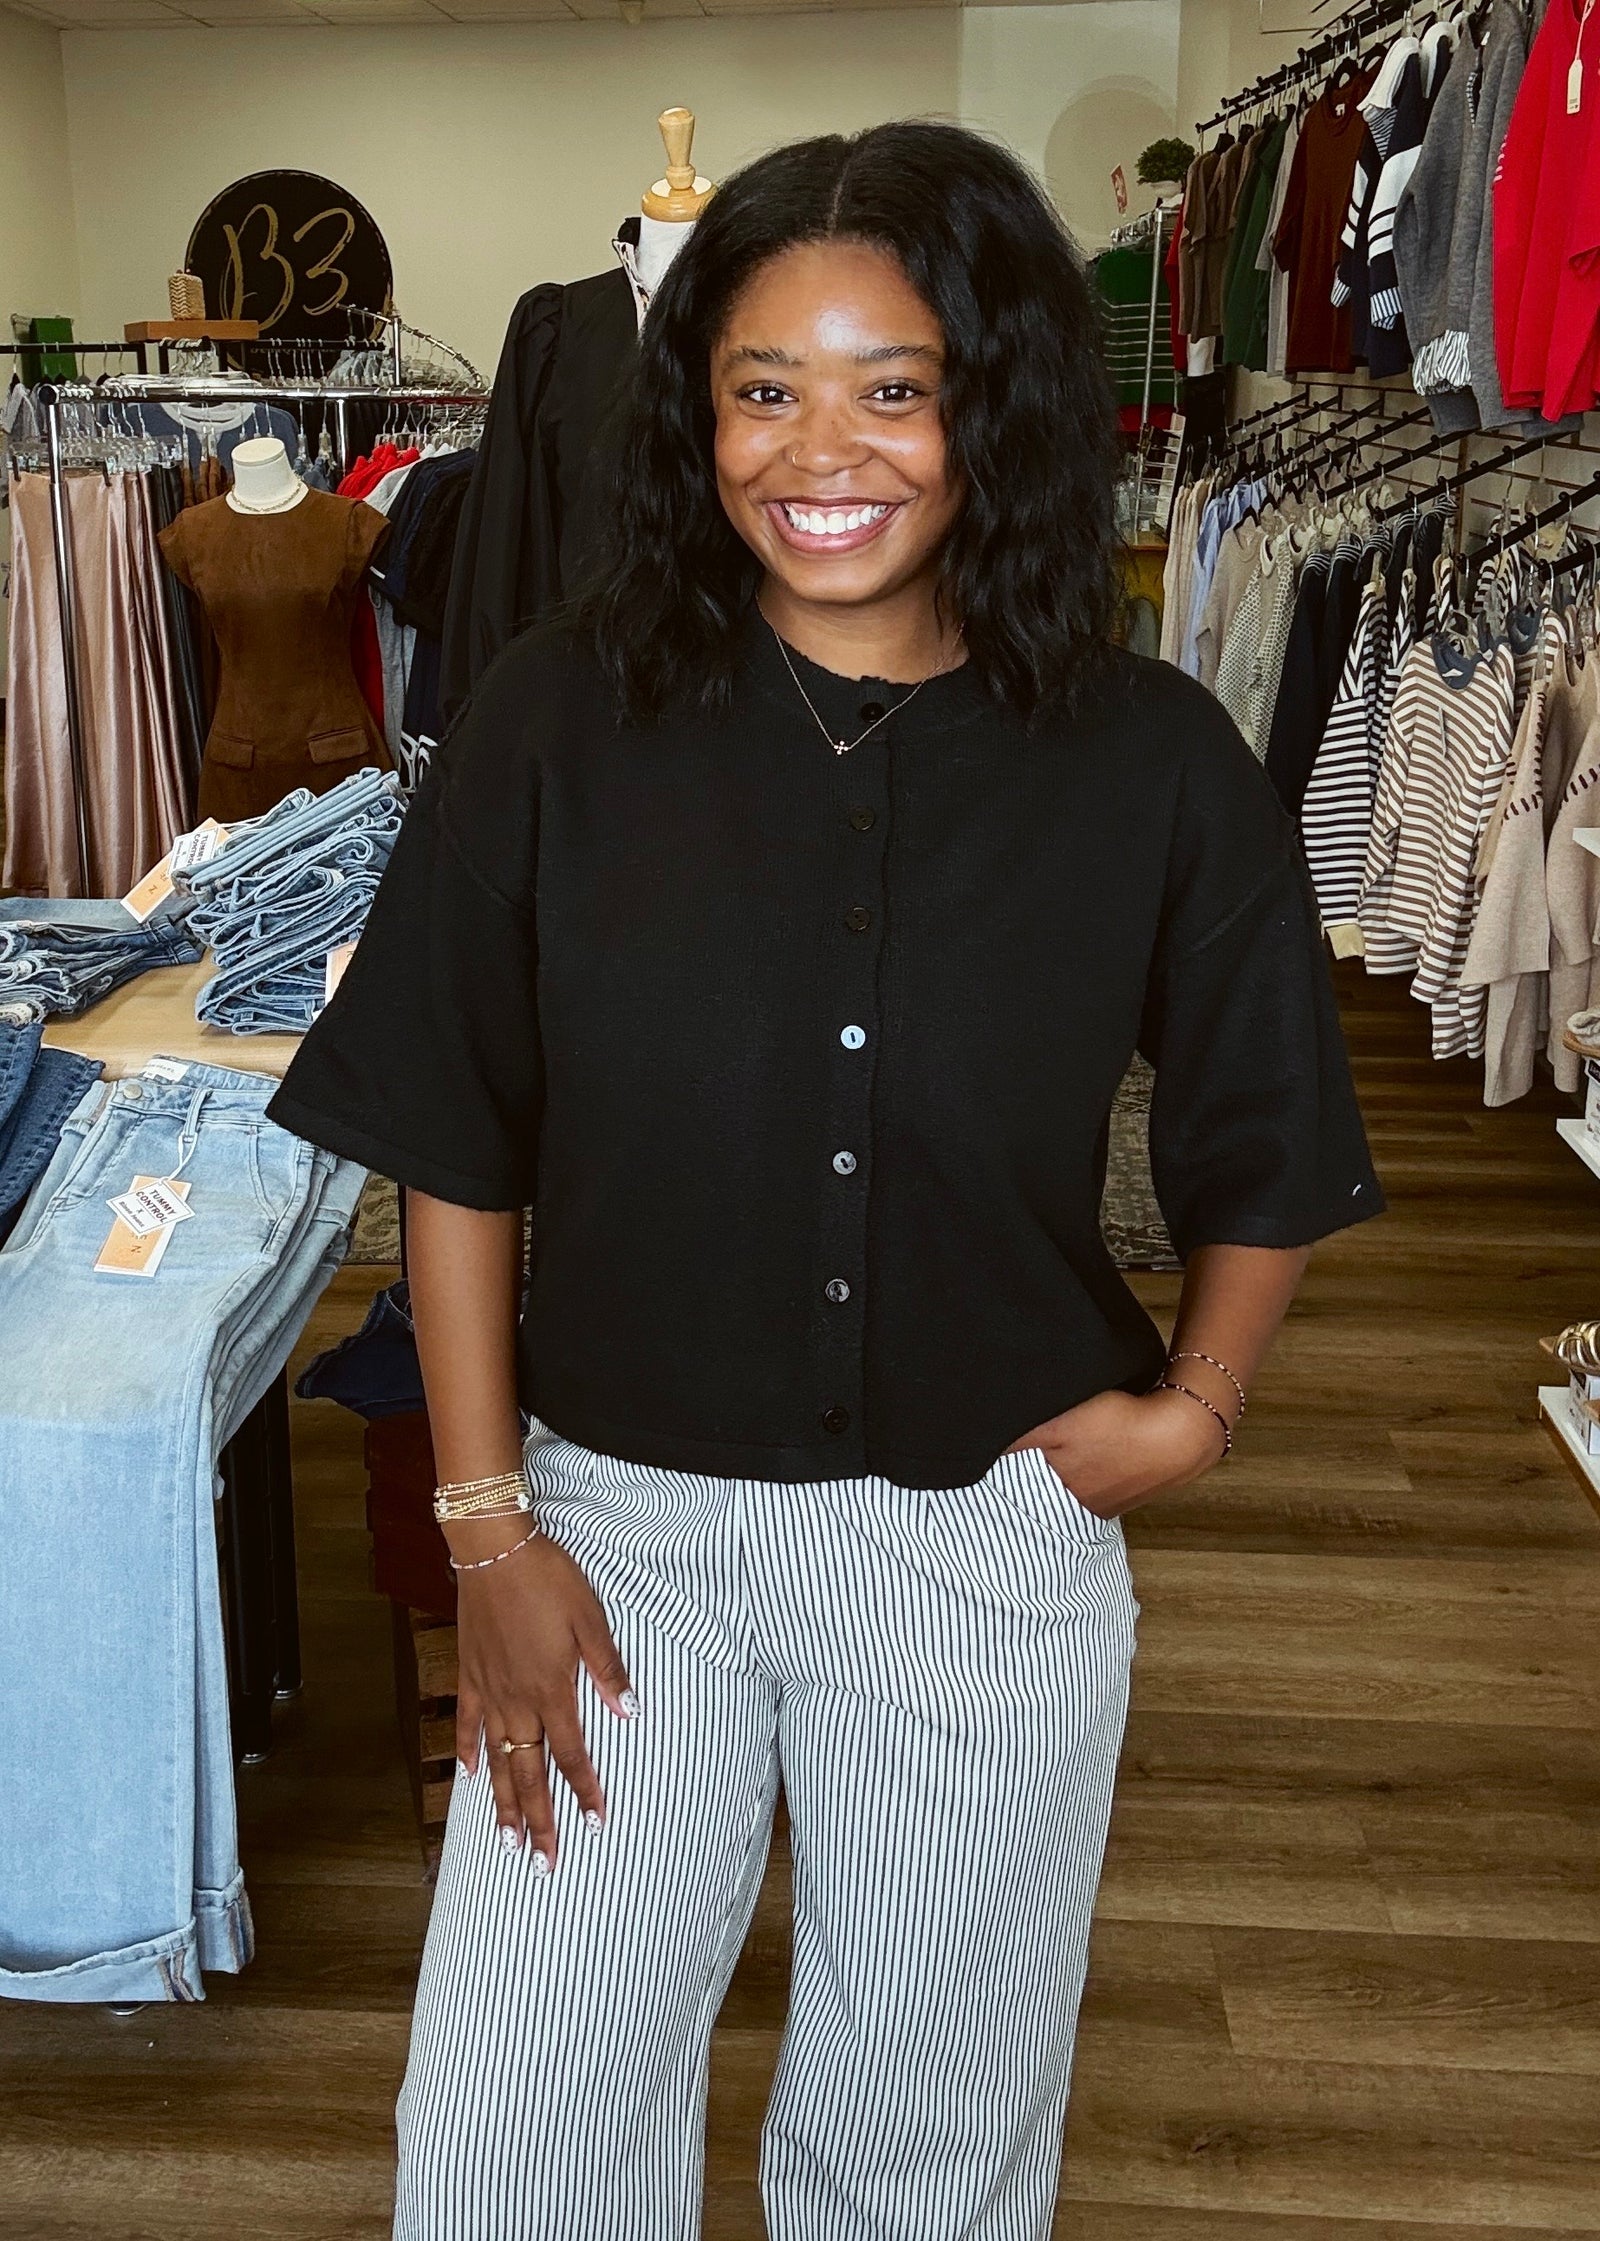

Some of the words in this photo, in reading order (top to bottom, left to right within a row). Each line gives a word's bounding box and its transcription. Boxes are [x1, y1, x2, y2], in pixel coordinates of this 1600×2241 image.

[219, 204, 355, 331] B3
[136, 1191, 168, 1223] CONTROL
[149, 1188, 177, 1215] TUMMY
